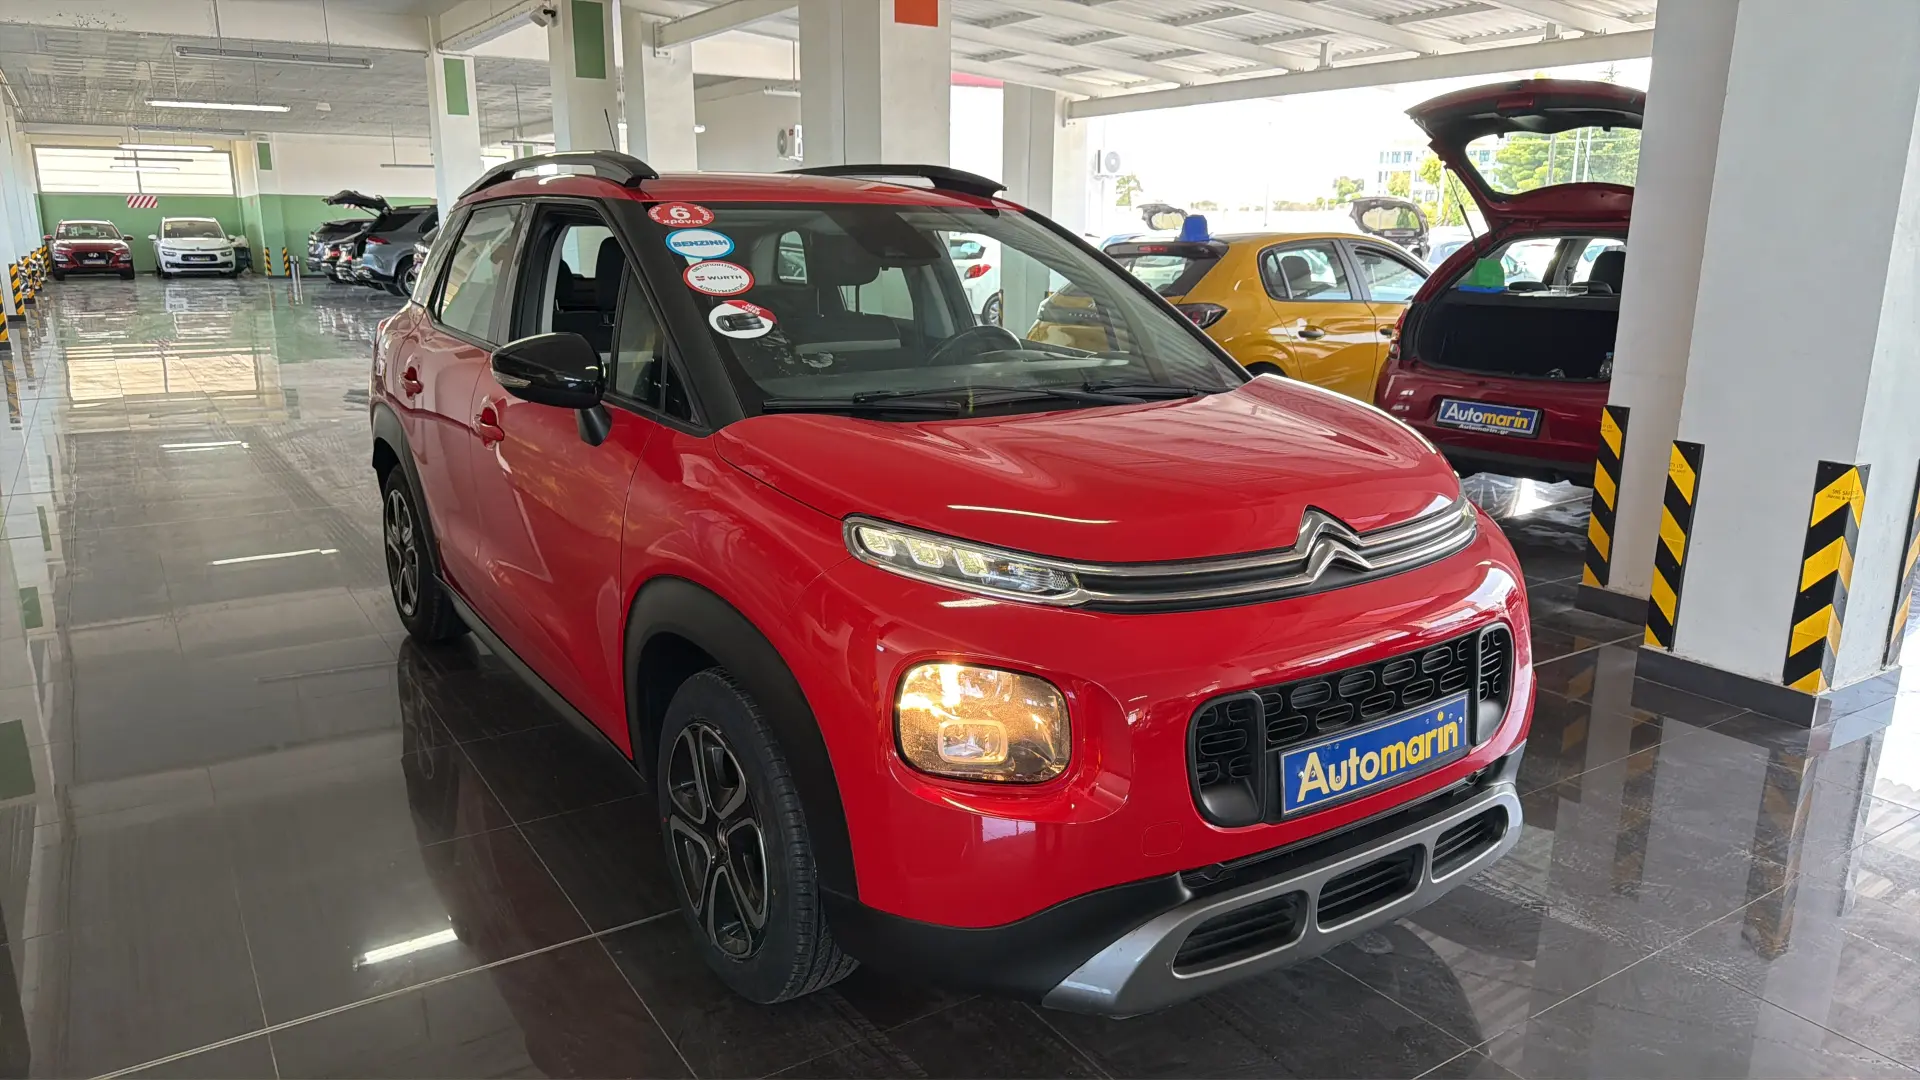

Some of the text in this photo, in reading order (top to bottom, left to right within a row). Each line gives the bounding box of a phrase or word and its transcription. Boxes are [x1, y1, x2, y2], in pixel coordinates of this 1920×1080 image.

[669, 207, 691, 220] 6
[1444, 403, 1528, 429] Automarin
[1296, 711, 1459, 803] Automarin
